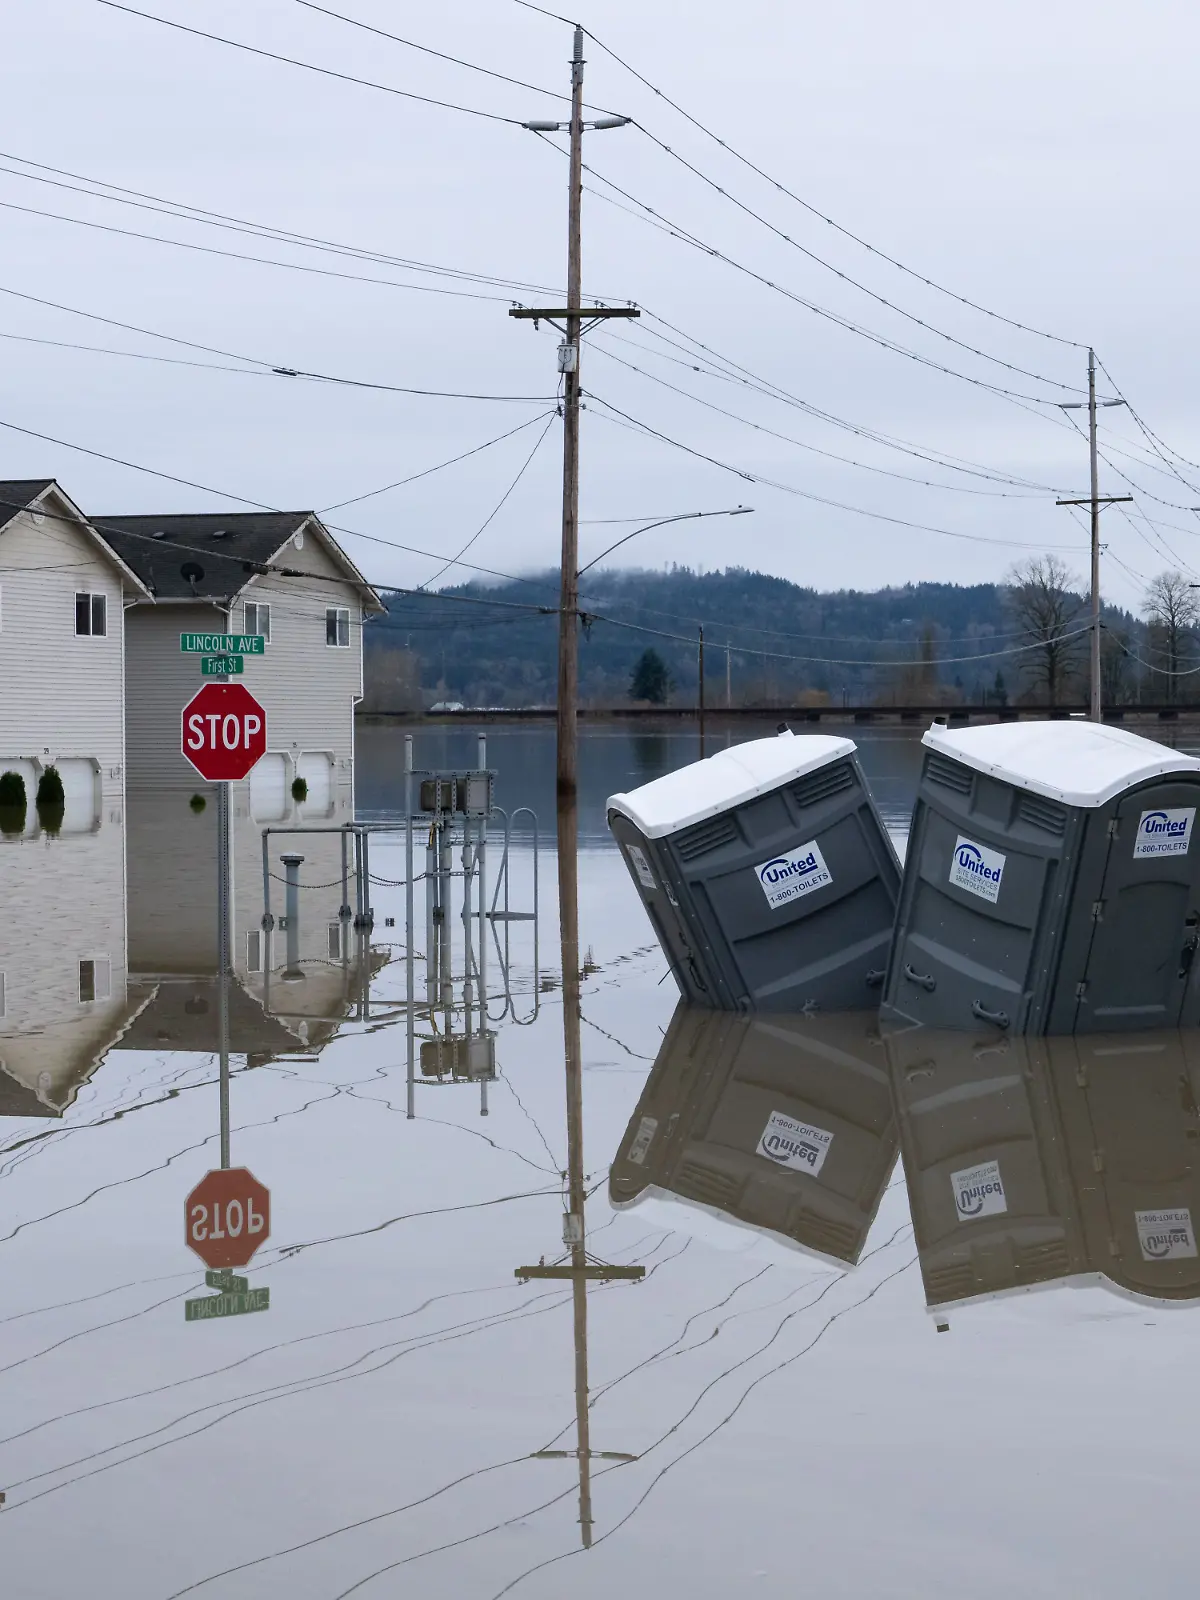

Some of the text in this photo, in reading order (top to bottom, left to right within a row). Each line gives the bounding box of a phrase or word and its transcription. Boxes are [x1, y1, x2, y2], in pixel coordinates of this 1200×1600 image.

[186, 635, 259, 652] LINCOLN AVE
[207, 657, 237, 673] First St
[187, 713, 261, 750] STOP
[1145, 817, 1188, 834] United
[1136, 842, 1188, 853] 1-800-TOILETS
[766, 852, 817, 883] United
[958, 850, 1002, 883] United
[769, 872, 829, 903] 1-800-TOILETS
